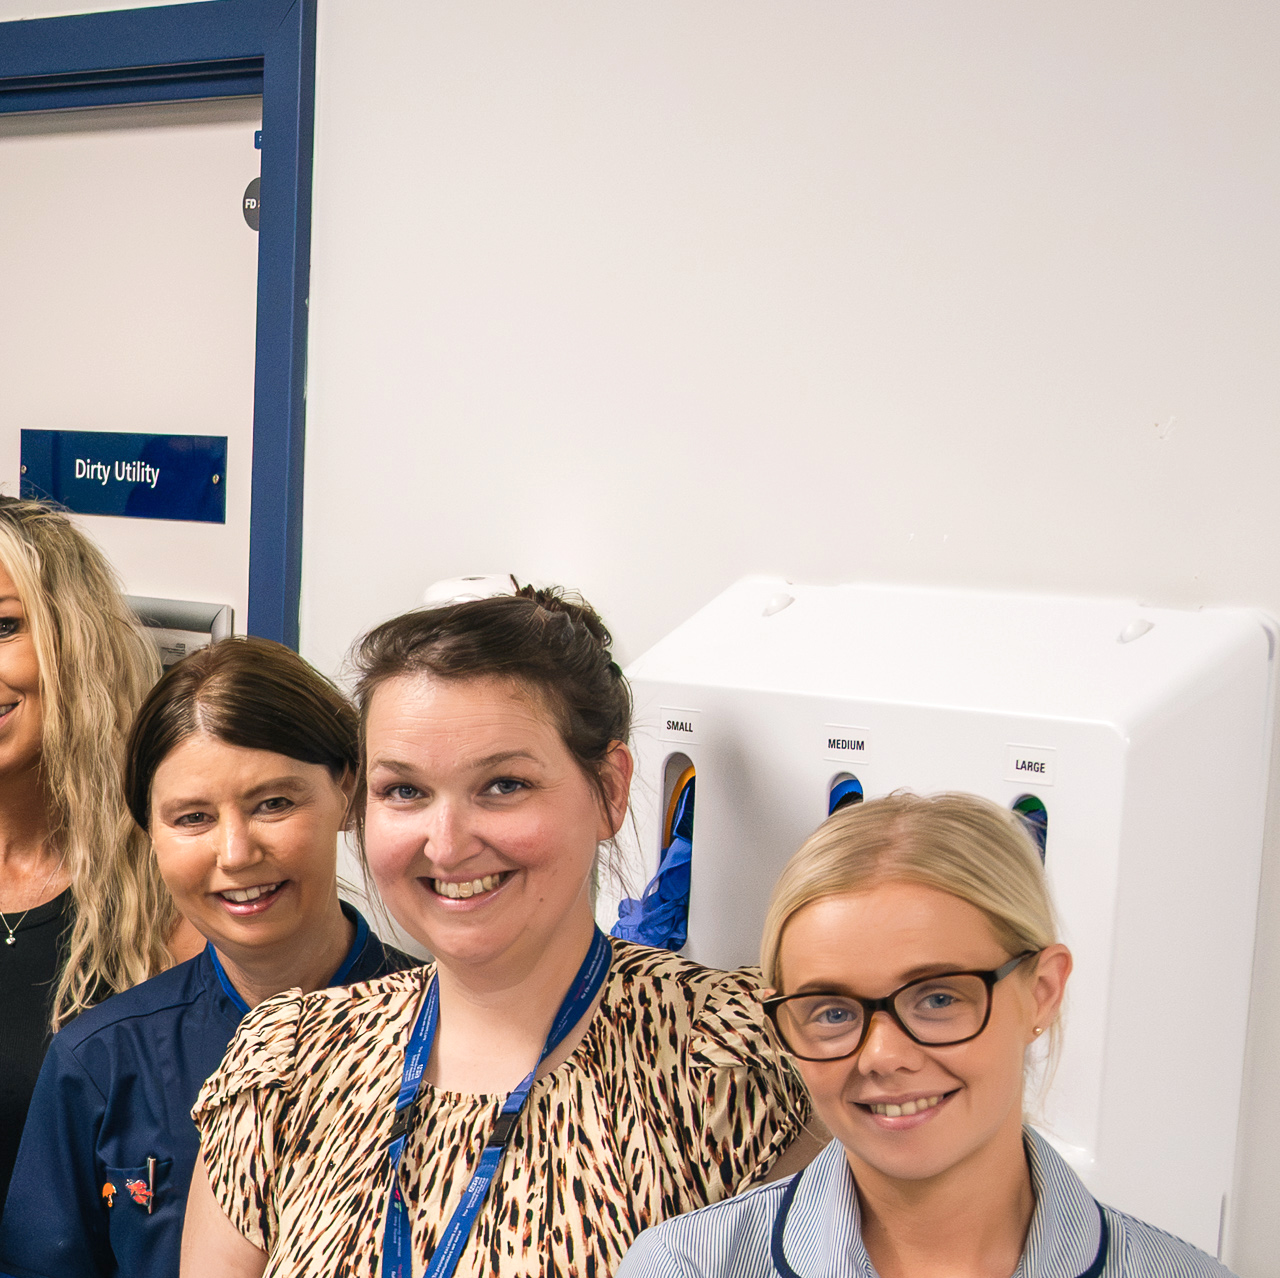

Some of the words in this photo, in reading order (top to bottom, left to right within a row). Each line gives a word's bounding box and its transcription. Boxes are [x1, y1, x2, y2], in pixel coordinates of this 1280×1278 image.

[245, 199, 256, 209] FD
[75, 459, 111, 485] Dirty
[115, 461, 159, 488] Utility
[666, 719, 693, 733] SMALL
[827, 738, 865, 751] MEDIUM
[1015, 759, 1046, 773] LARGE
